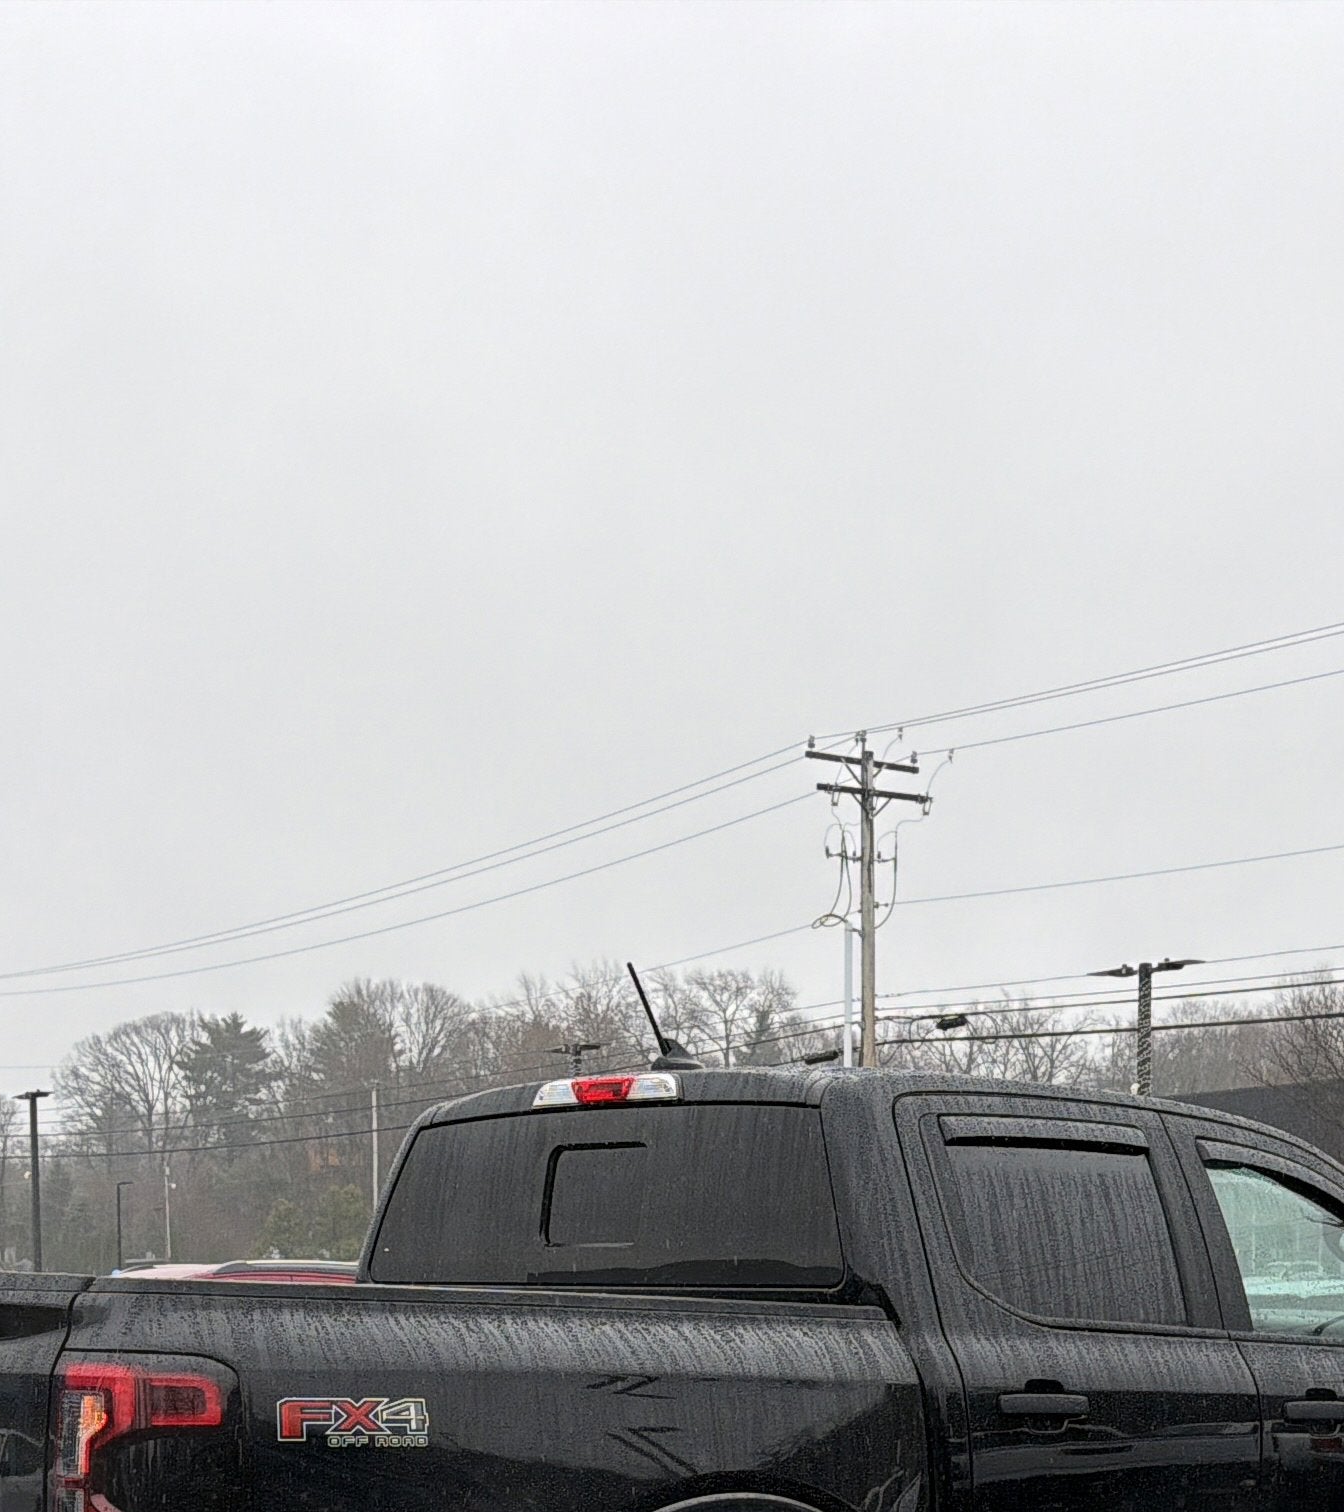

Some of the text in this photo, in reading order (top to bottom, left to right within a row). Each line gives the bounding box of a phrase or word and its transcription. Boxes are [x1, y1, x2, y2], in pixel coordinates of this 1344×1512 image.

[277, 1398, 430, 1441] FX4
[328, 1435, 428, 1447] OFF ROAD
